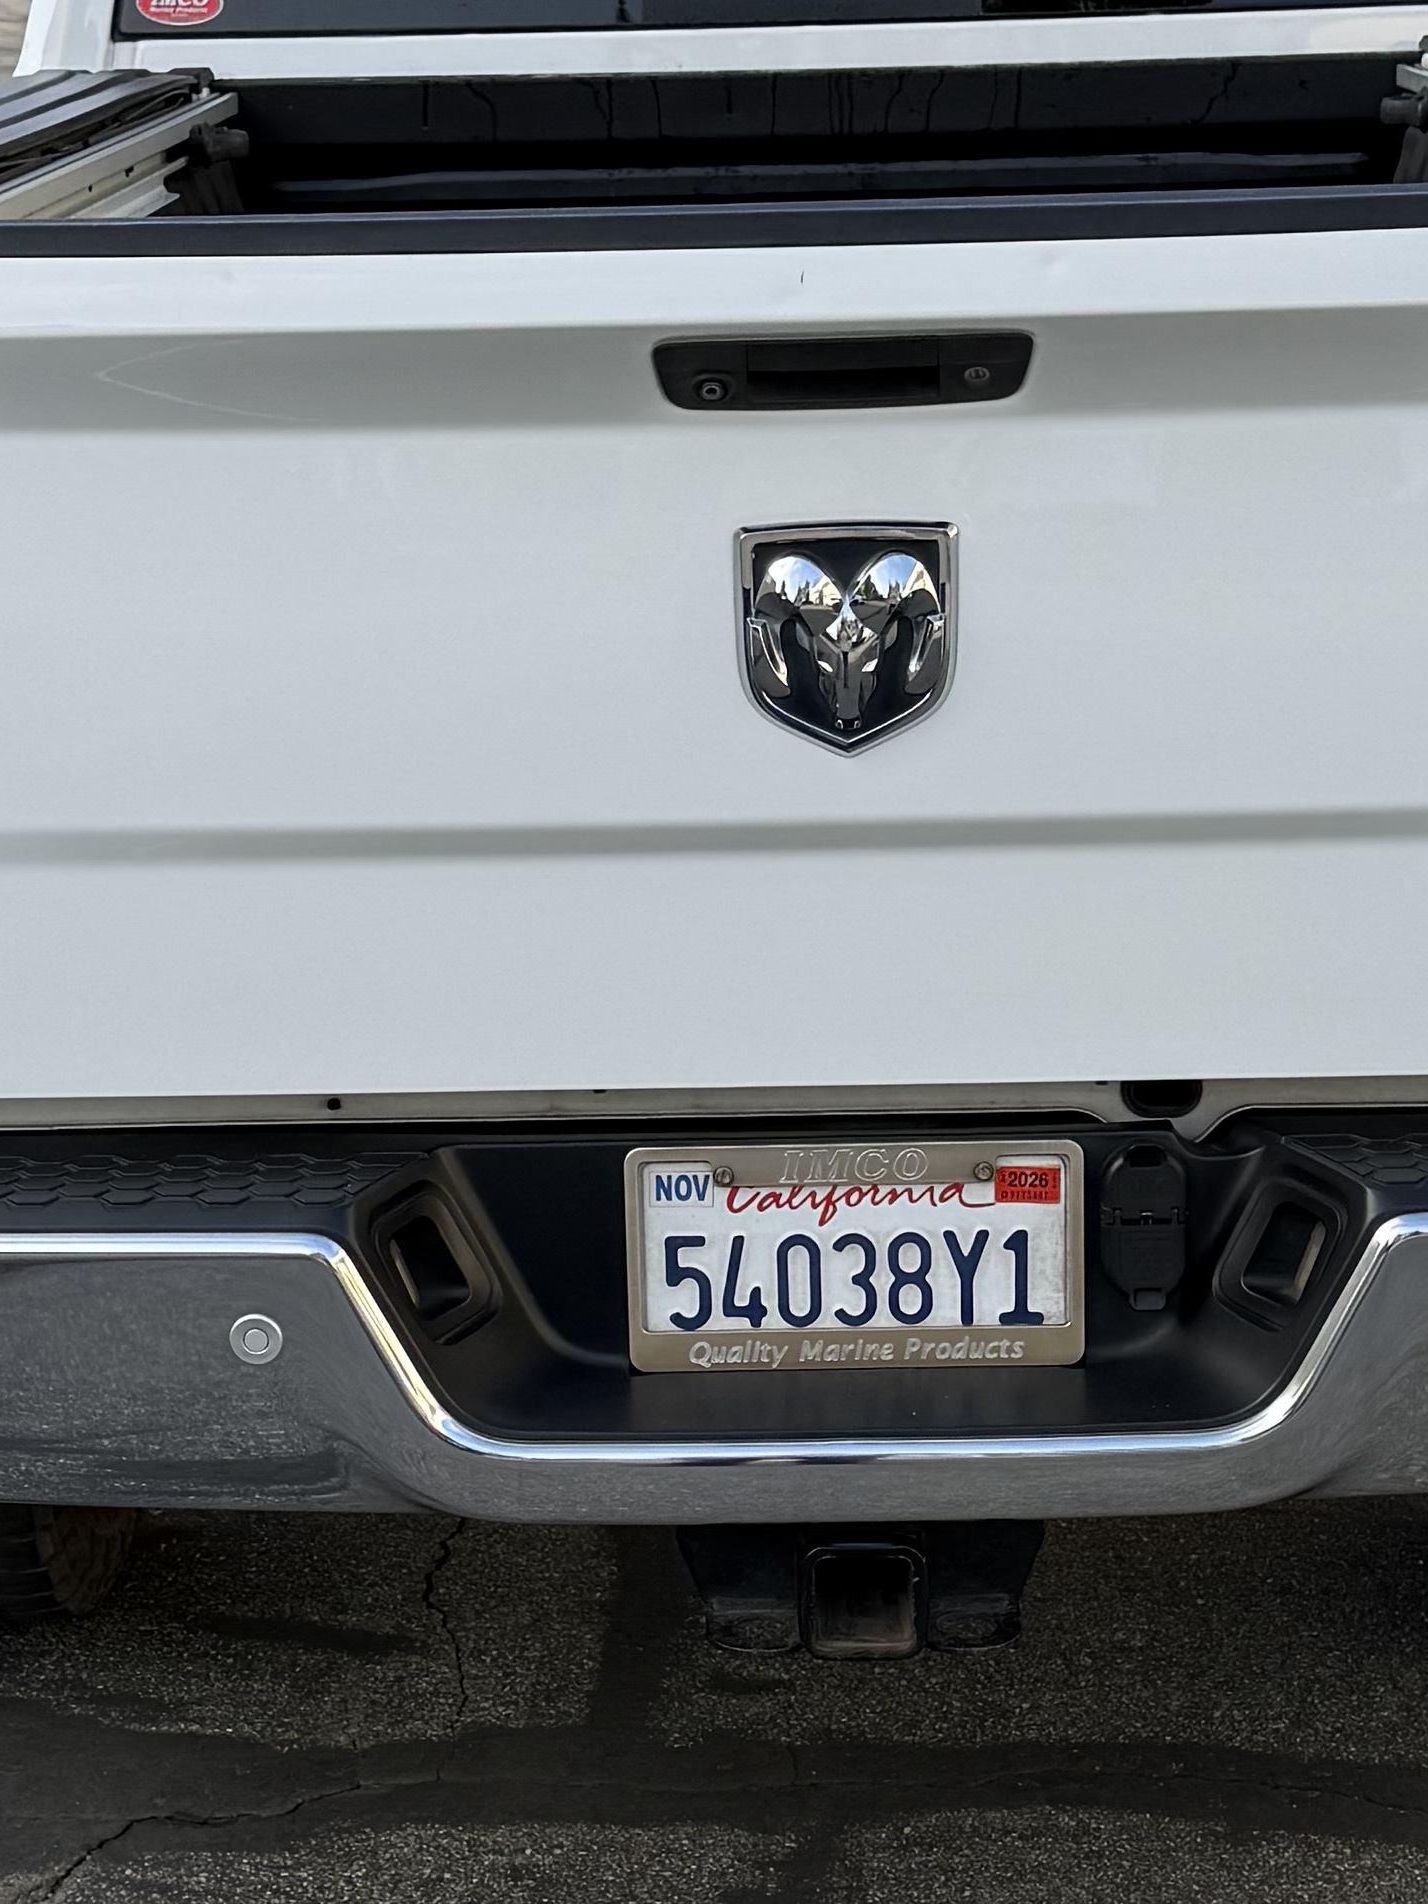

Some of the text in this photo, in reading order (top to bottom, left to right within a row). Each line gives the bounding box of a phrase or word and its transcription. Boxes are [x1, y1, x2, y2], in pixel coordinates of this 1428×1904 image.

[778, 1148, 929, 1184] IMCO
[1007, 1171, 1049, 1188] 2026
[655, 1174, 710, 1202] NOV
[726, 1183, 995, 1227] California
[664, 1229, 1045, 1331] 54038Y1
[689, 1336, 1025, 1369] Quality Marine Products
